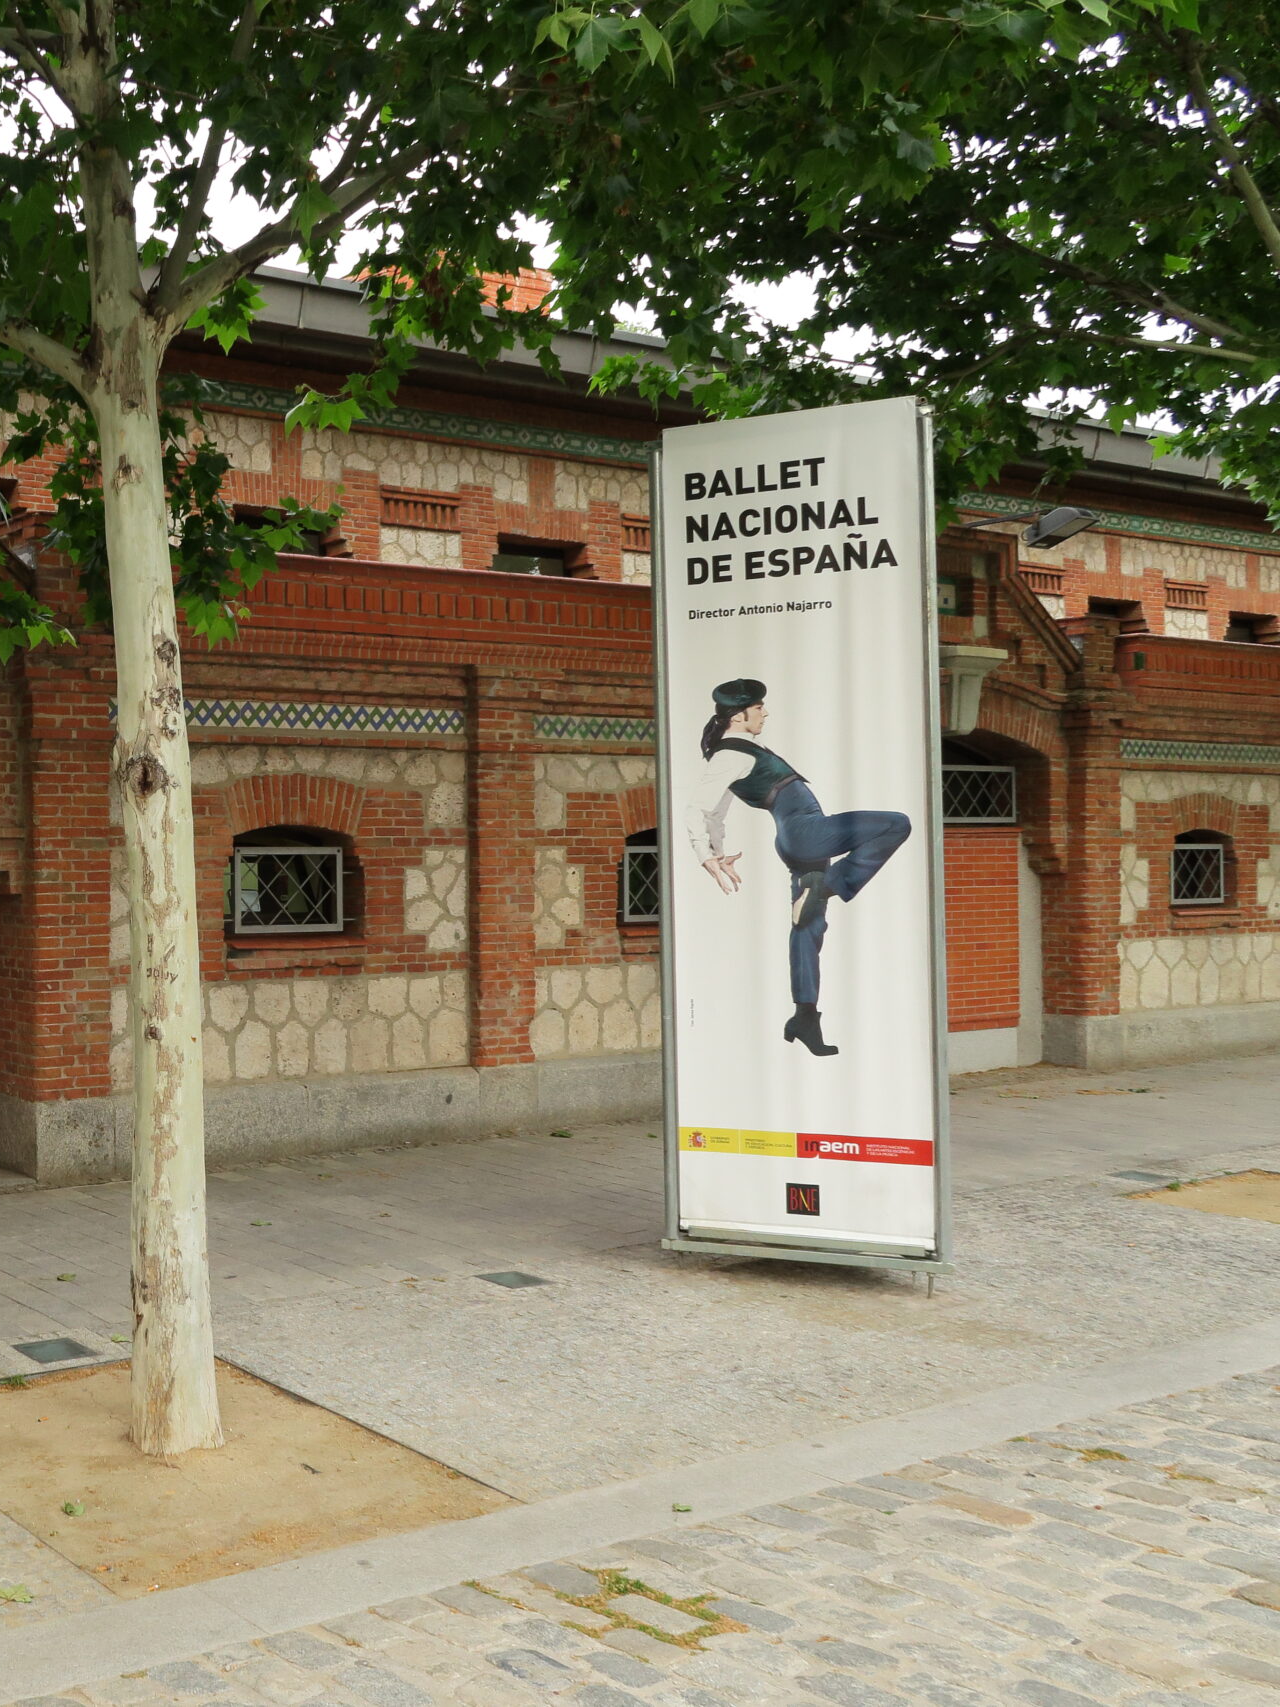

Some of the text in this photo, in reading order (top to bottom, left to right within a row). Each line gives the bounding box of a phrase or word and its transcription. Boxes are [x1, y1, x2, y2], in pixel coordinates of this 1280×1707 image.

[684, 456, 825, 501] BALLET
[685, 496, 879, 544] NACIONAL
[687, 532, 899, 586] DE ESPAÑA
[688, 600, 833, 620] Director Antonio Najarro
[803, 1140, 860, 1155] inaem
[788, 1186, 818, 1213] BNE
